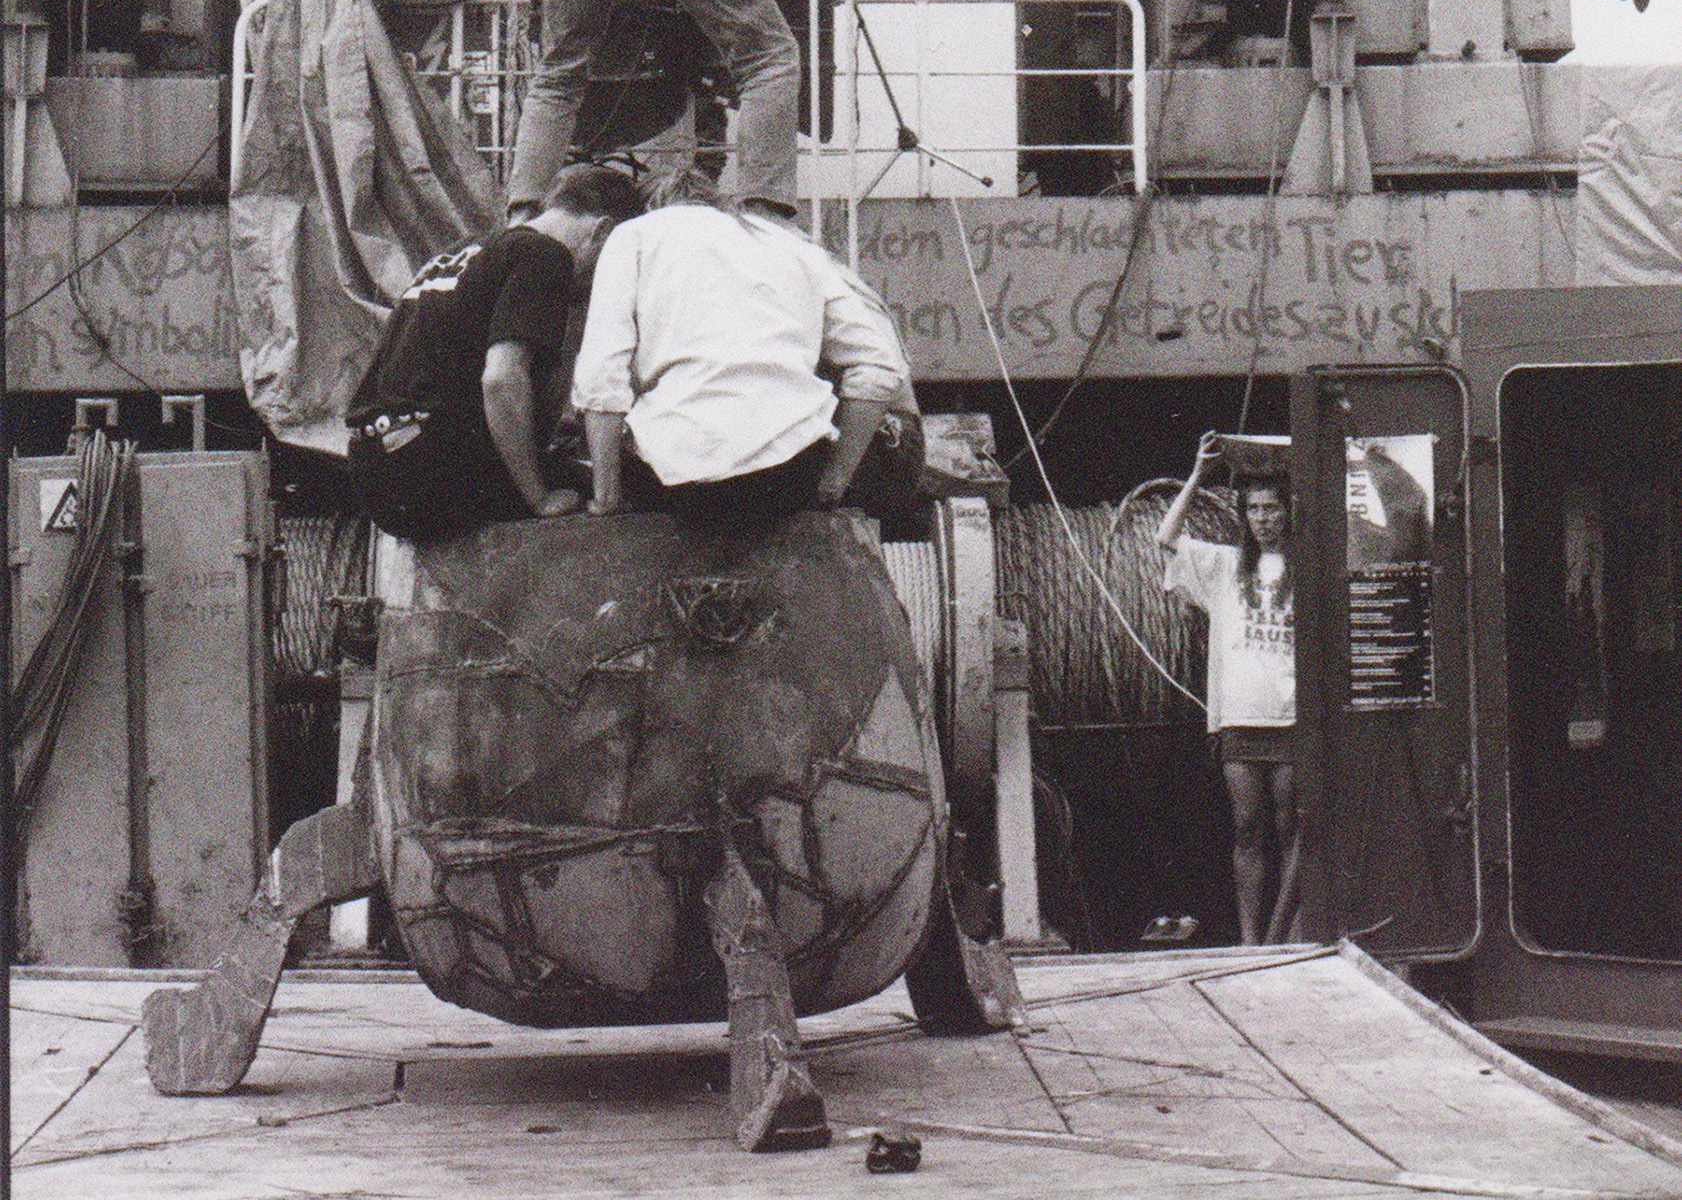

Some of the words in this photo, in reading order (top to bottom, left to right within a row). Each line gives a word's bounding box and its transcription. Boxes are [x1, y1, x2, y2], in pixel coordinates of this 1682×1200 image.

[969, 207, 1283, 275] geschlachteten
[1286, 215, 1416, 286] Tier
[978, 272, 1058, 348] des
